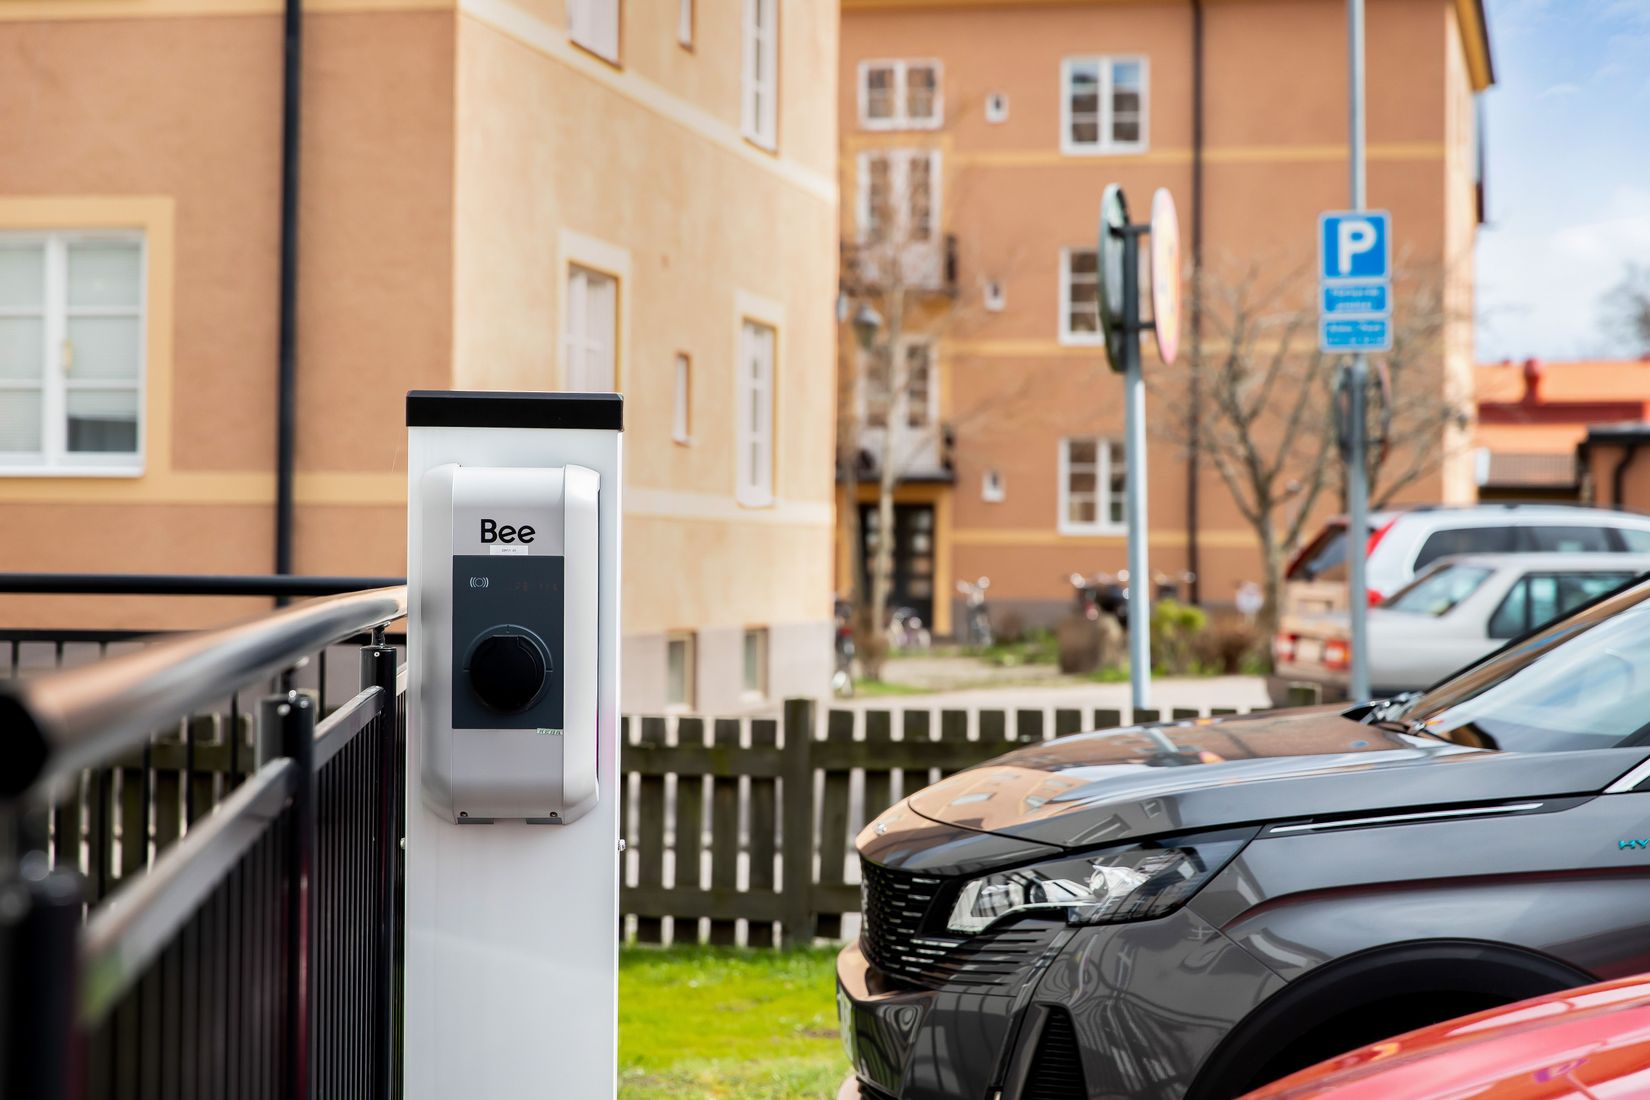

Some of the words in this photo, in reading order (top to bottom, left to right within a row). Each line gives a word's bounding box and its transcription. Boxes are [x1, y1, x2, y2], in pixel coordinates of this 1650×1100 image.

[1338, 220, 1377, 275] P
[480, 519, 536, 544] Bee
[1618, 839, 1650, 850] HY
